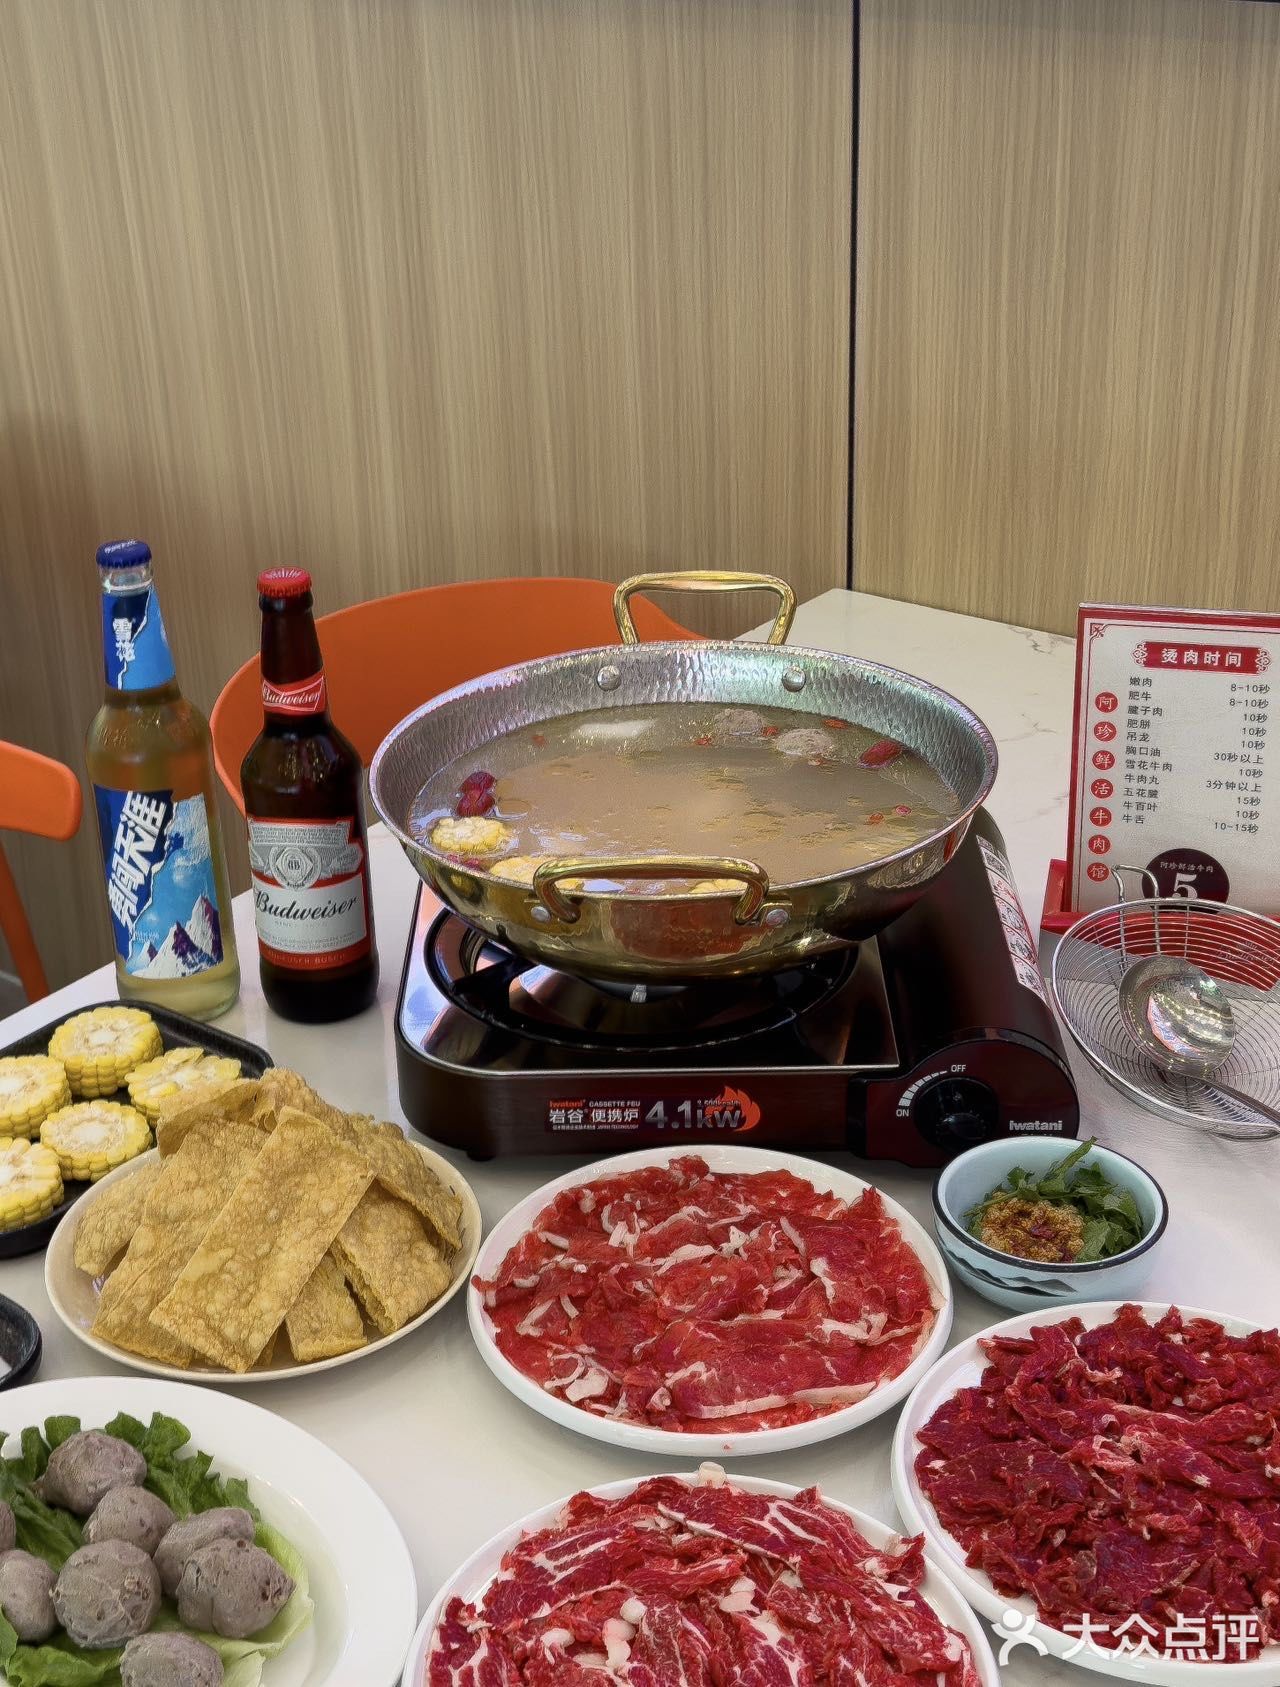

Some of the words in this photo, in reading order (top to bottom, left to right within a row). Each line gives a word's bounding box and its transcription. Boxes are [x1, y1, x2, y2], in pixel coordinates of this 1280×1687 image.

[1161, 648, 1242, 667] 烫肉时间
[1129, 677, 1153, 687] 嫩肉
[1230, 684, 1270, 694] 8-10秒
[263, 685, 320, 706] Budweiser
[1128, 691, 1152, 701] 肥牛
[1229, 698, 1269, 709] 8-10秒
[1127, 705, 1163, 717] 腱子肉
[1243, 713, 1268, 723] 10秒
[1126, 732, 1150, 742] 吊龙
[1242, 727, 1267, 737] 10秒
[1241, 741, 1266, 750] 10秒
[1125, 746, 1161, 757] 胸口油
[1213, 752, 1264, 765] 30秒以上
[1125, 759, 1173, 772] 雪花牛肉
[1124, 773, 1160, 785] 牛肉丸
[1239, 769, 1263, 779] 10秒
[1206, 780, 1262, 793] 3分钟以上
[1122, 801, 1158, 812] 牛百叶
[1237, 797, 1261, 806] 15秒
[1121, 814, 1146, 824] 牛舌
[1235, 811, 1260, 820] 10秒
[1213, 822, 1259, 834] 10-15秒
[108, 790, 168, 936] 勇闯天涯
[254, 888, 360, 921] Budweiser
[951, 1064, 967, 1072] OFF
[549, 1109, 584, 1123] 岩谷
[591, 1109, 639, 1122] 便携炉
[896, 1109, 909, 1117] ON
